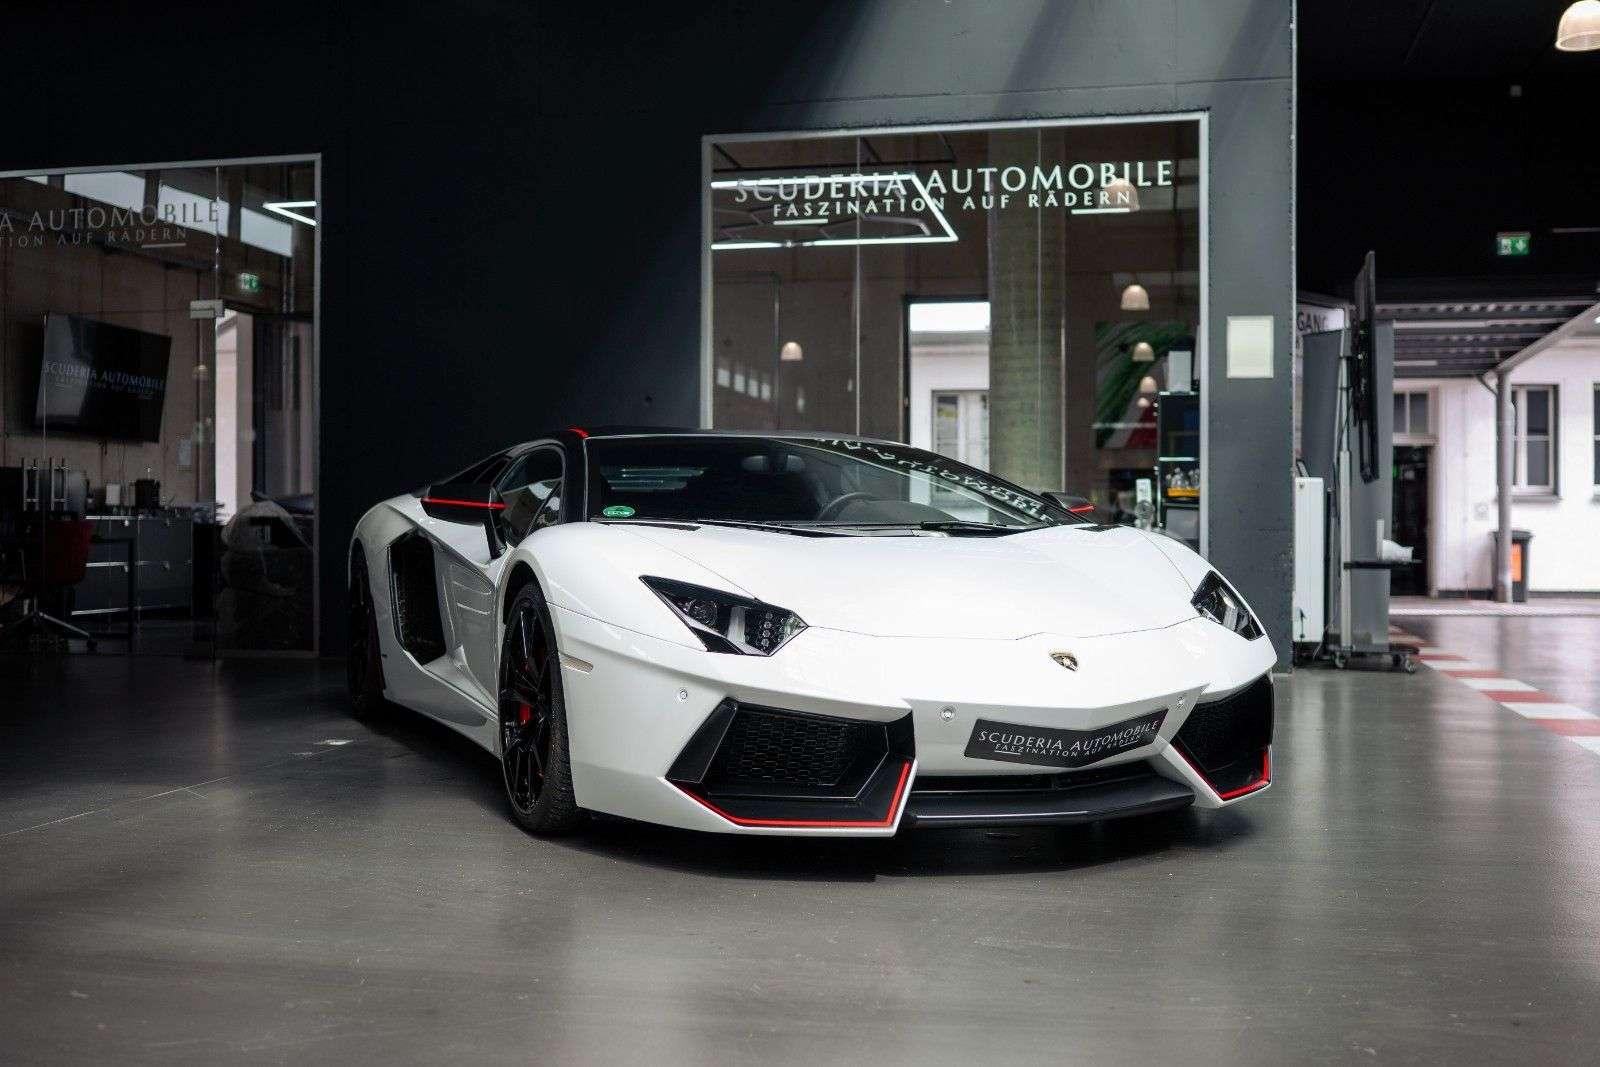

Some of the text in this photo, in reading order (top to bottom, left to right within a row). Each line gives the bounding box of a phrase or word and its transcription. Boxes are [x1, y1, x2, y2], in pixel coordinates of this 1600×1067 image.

[734, 159, 1173, 203] SCUDERIA AUTOMOBILE
[28, 201, 220, 232] AUTOMOBILE
[773, 189, 1131, 218] FASZINATION AUF RÄDERN
[57, 230, 92, 246] AUF
[978, 720, 1158, 751] SCUDERIA AUTOMOBILE
[995, 742, 1077, 757] FASZINATION
